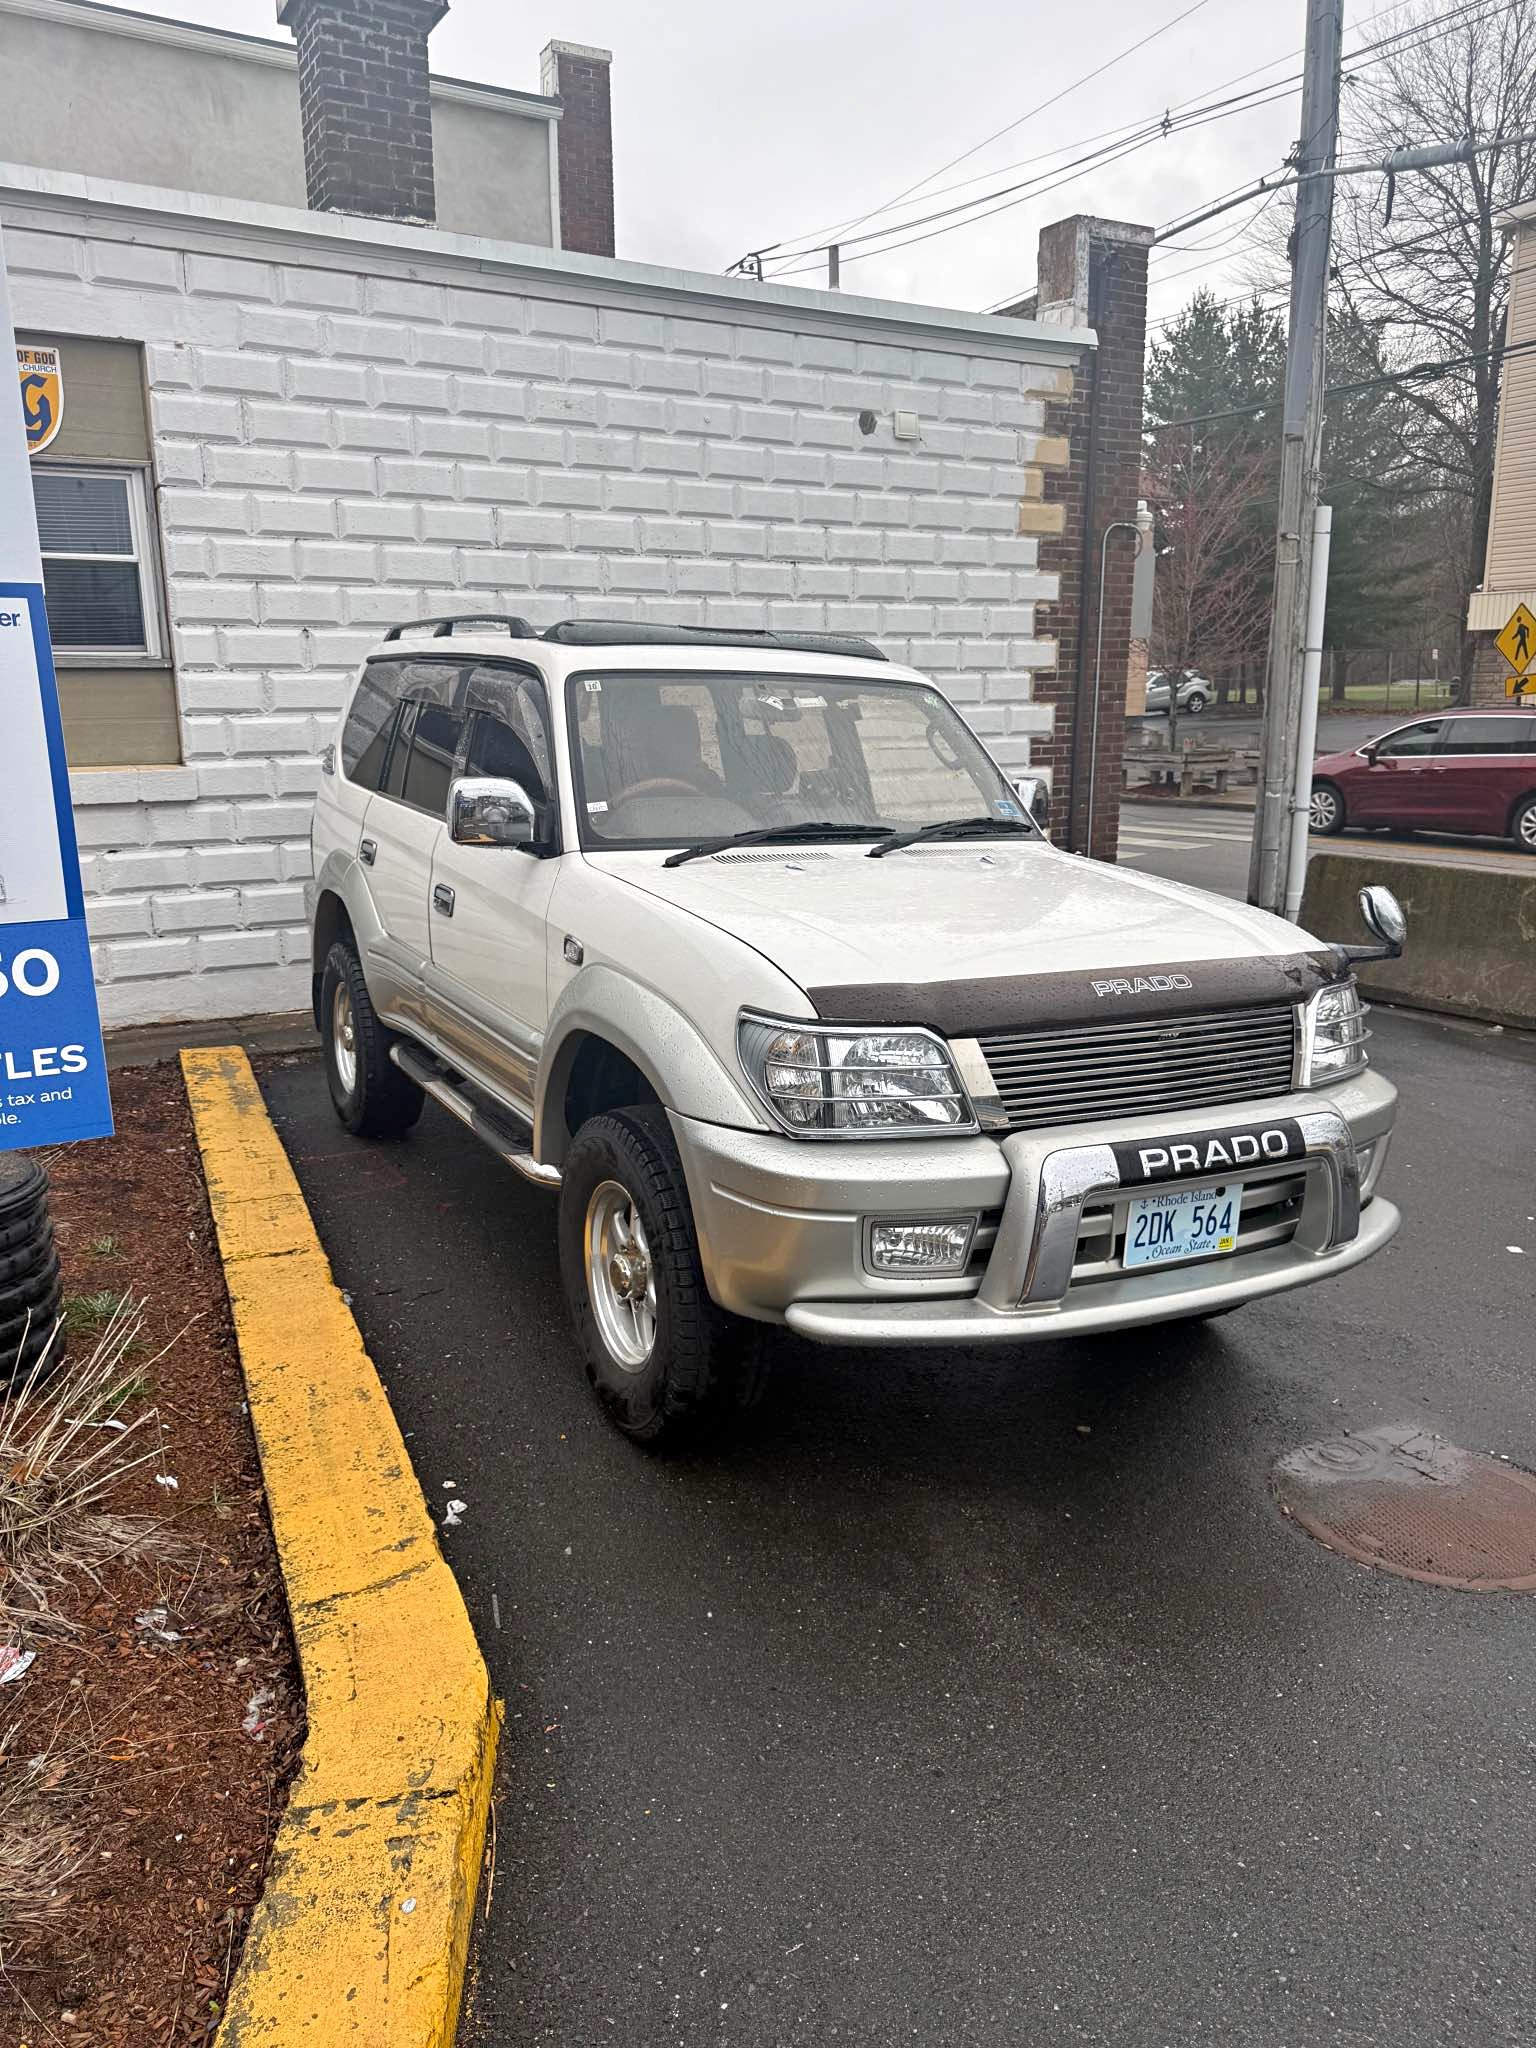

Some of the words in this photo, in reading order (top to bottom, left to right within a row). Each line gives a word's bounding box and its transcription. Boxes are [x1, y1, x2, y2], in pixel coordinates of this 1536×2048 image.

[34, 351, 55, 365] GOD
[22, 364, 57, 373] CHURCH
[1091, 974, 1193, 997] PRADO
[0, 1044, 88, 1080] LES
[6, 1094, 36, 1107] tax
[40, 1086, 73, 1103] and
[0, 1112, 22, 1125] le.
[1139, 1130, 1288, 1177] PRADO
[1156, 1192, 1188, 1208] Rhode
[1191, 1190, 1217, 1203] Island
[1134, 1209, 1177, 1248] 2DK
[1191, 1201, 1233, 1238] 564
[1151, 1244, 1182, 1259] Ocean
[1183, 1239, 1212, 1254] State
